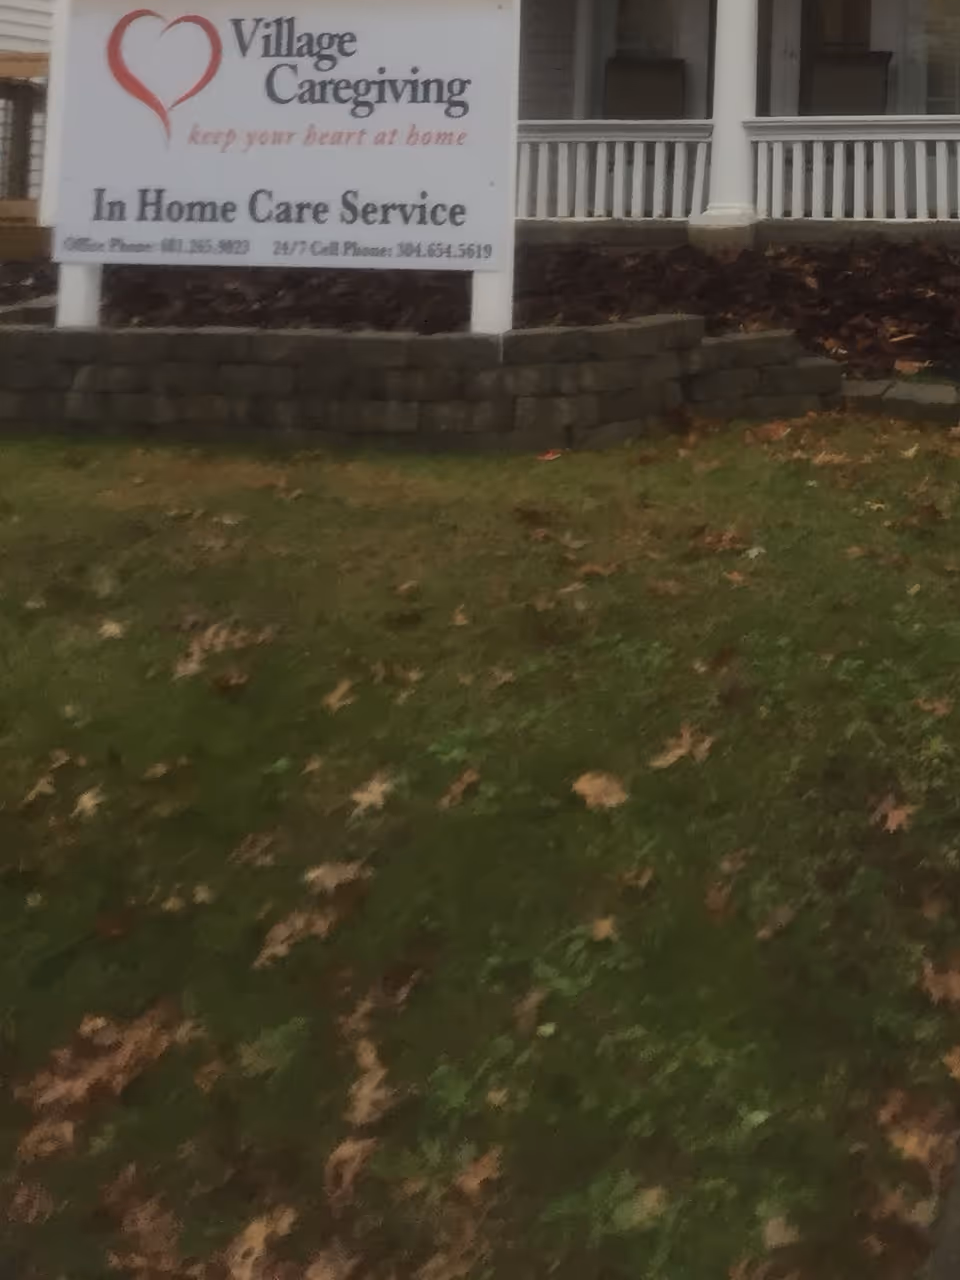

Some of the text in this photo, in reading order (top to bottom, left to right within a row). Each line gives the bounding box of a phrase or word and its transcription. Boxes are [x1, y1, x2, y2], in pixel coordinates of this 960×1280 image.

[230, 17, 357, 71] Village
[265, 63, 471, 118] Caregiving
[187, 123, 467, 154] keep your heart at home
[93, 188, 466, 227] In Home Care Service
[310, 241, 339, 257] Cell
[343, 241, 393, 258] Phone:
